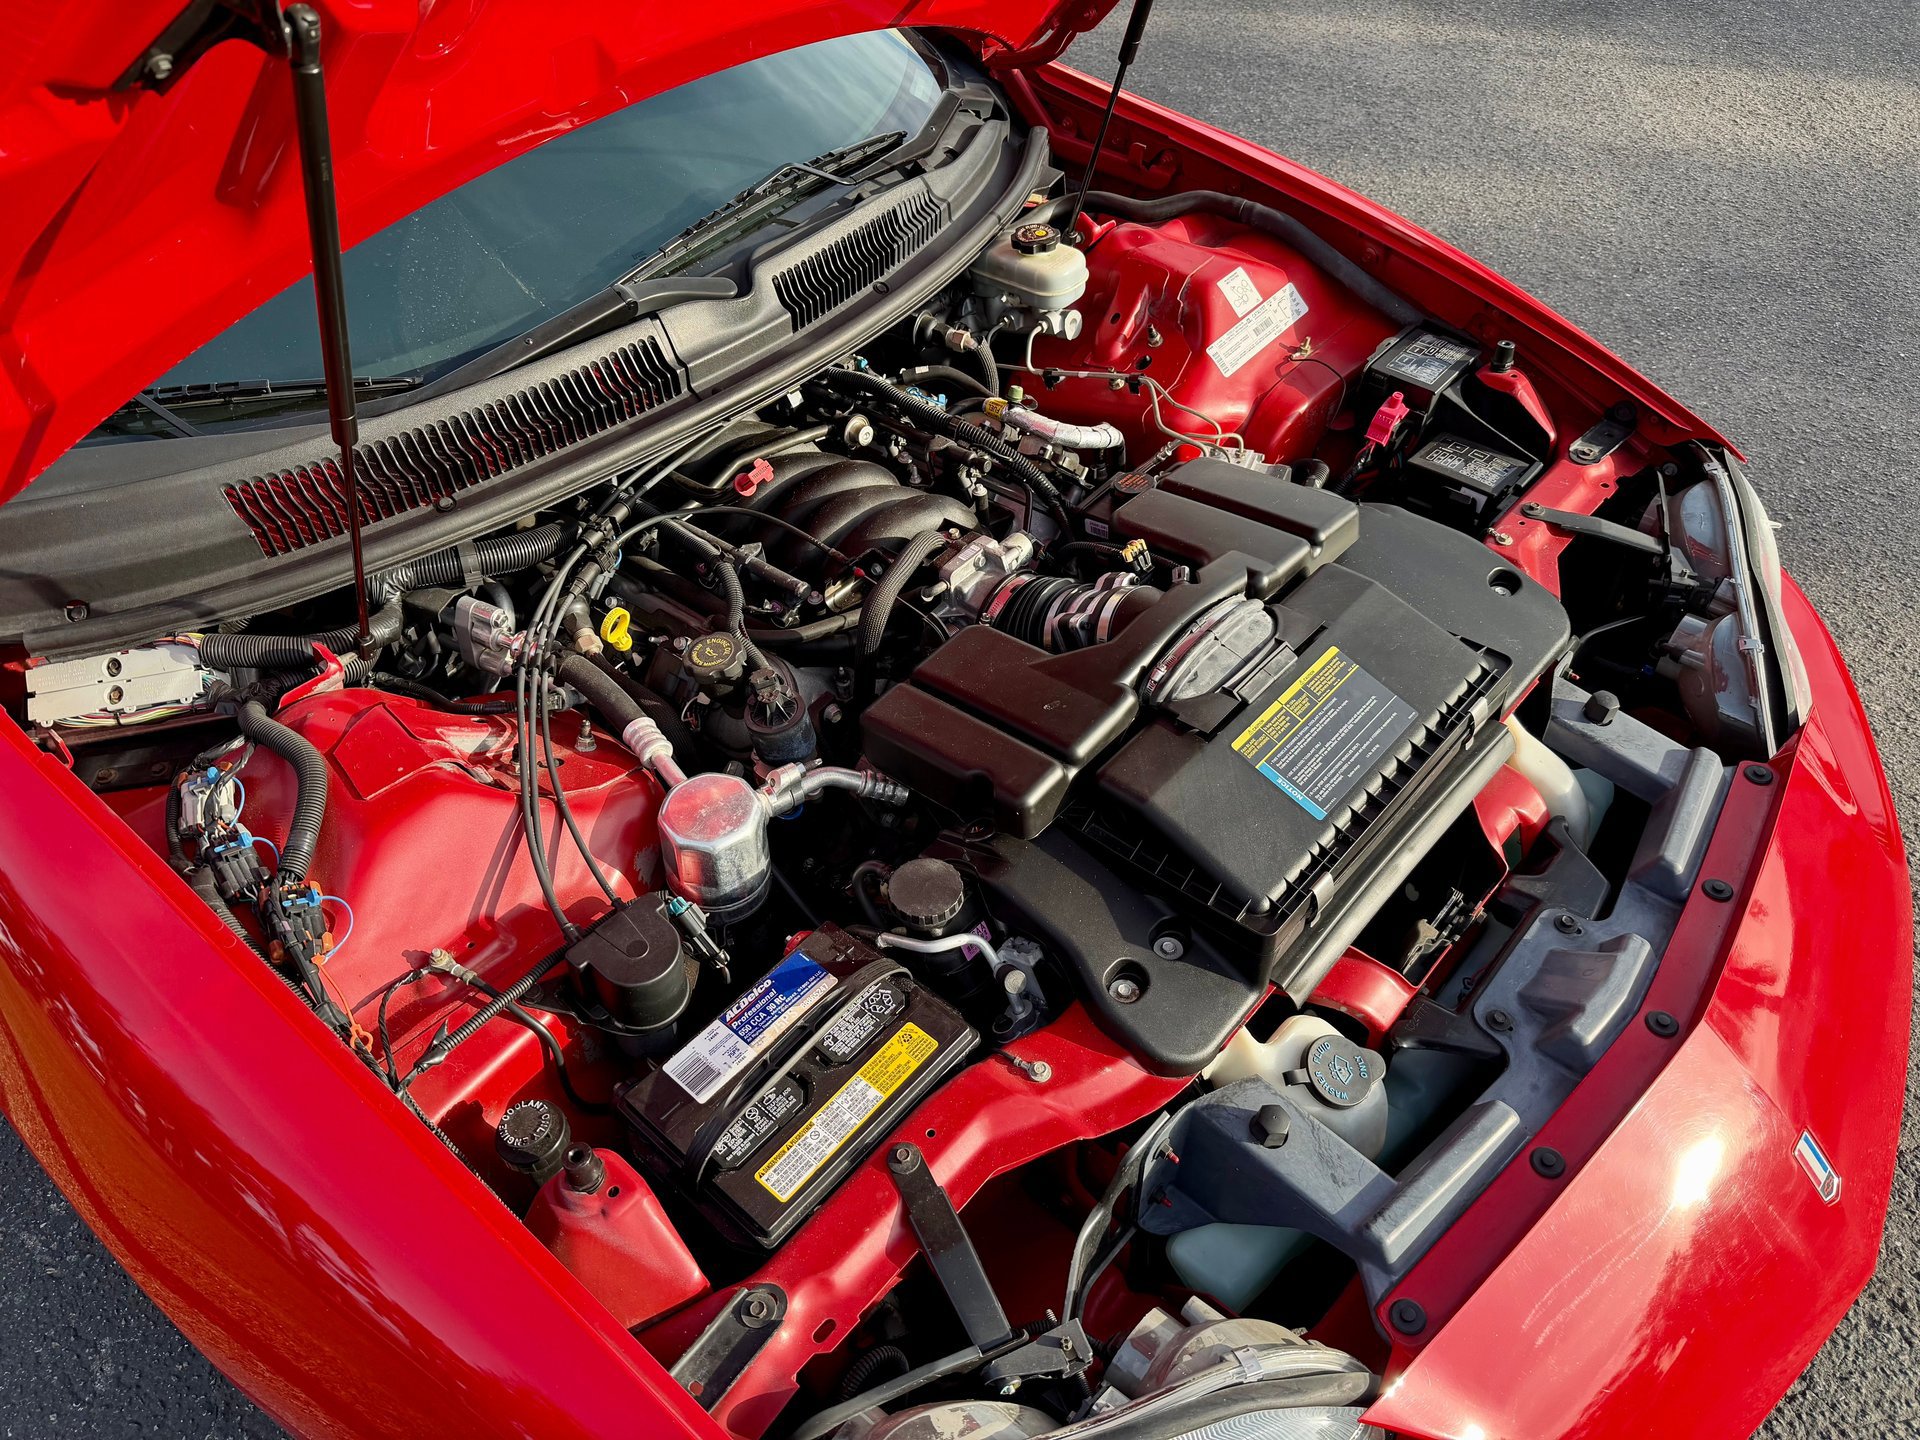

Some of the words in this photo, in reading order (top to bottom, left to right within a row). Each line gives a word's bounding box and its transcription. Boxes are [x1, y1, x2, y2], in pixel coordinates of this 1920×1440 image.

[1275, 776, 1304, 801] NOTICE
[721, 976, 774, 1022] ACDelco
[729, 987, 778, 1030] Professional
[737, 1022, 753, 1037] 650
[749, 1010, 767, 1026] CCA
[764, 1001, 777, 1013] 90
[773, 993, 787, 1005] RC
[1313, 1041, 1330, 1064] FLUID
[1353, 1055, 1367, 1079] ONLY
[1315, 1071, 1349, 1100] WASHER
[502, 1099, 548, 1121] COOLANT
[498, 1123, 529, 1147] ENGINE
[533, 1113, 550, 1140] ONLY
